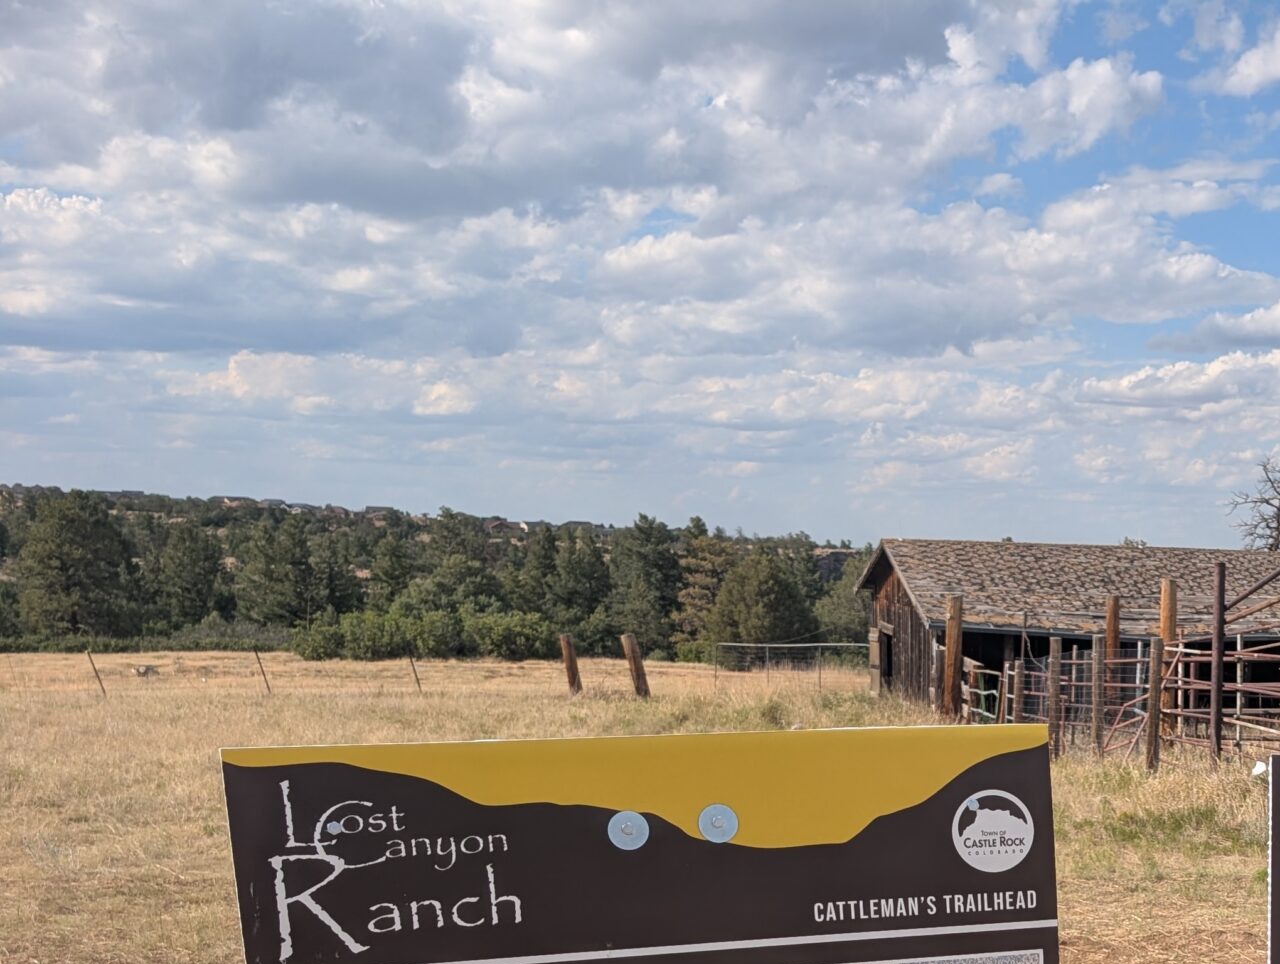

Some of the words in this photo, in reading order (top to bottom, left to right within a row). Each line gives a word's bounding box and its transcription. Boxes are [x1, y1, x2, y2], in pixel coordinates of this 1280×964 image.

[277, 779, 405, 848] Lost
[317, 801, 508, 869] Canyon
[964, 838, 997, 848] CASTLE
[1000, 837, 1025, 846] ROCK
[268, 853, 522, 964] Ranch
[815, 893, 937, 923] CATTLEMAN'S
[942, 889, 1038, 915] TRAILHEAD
